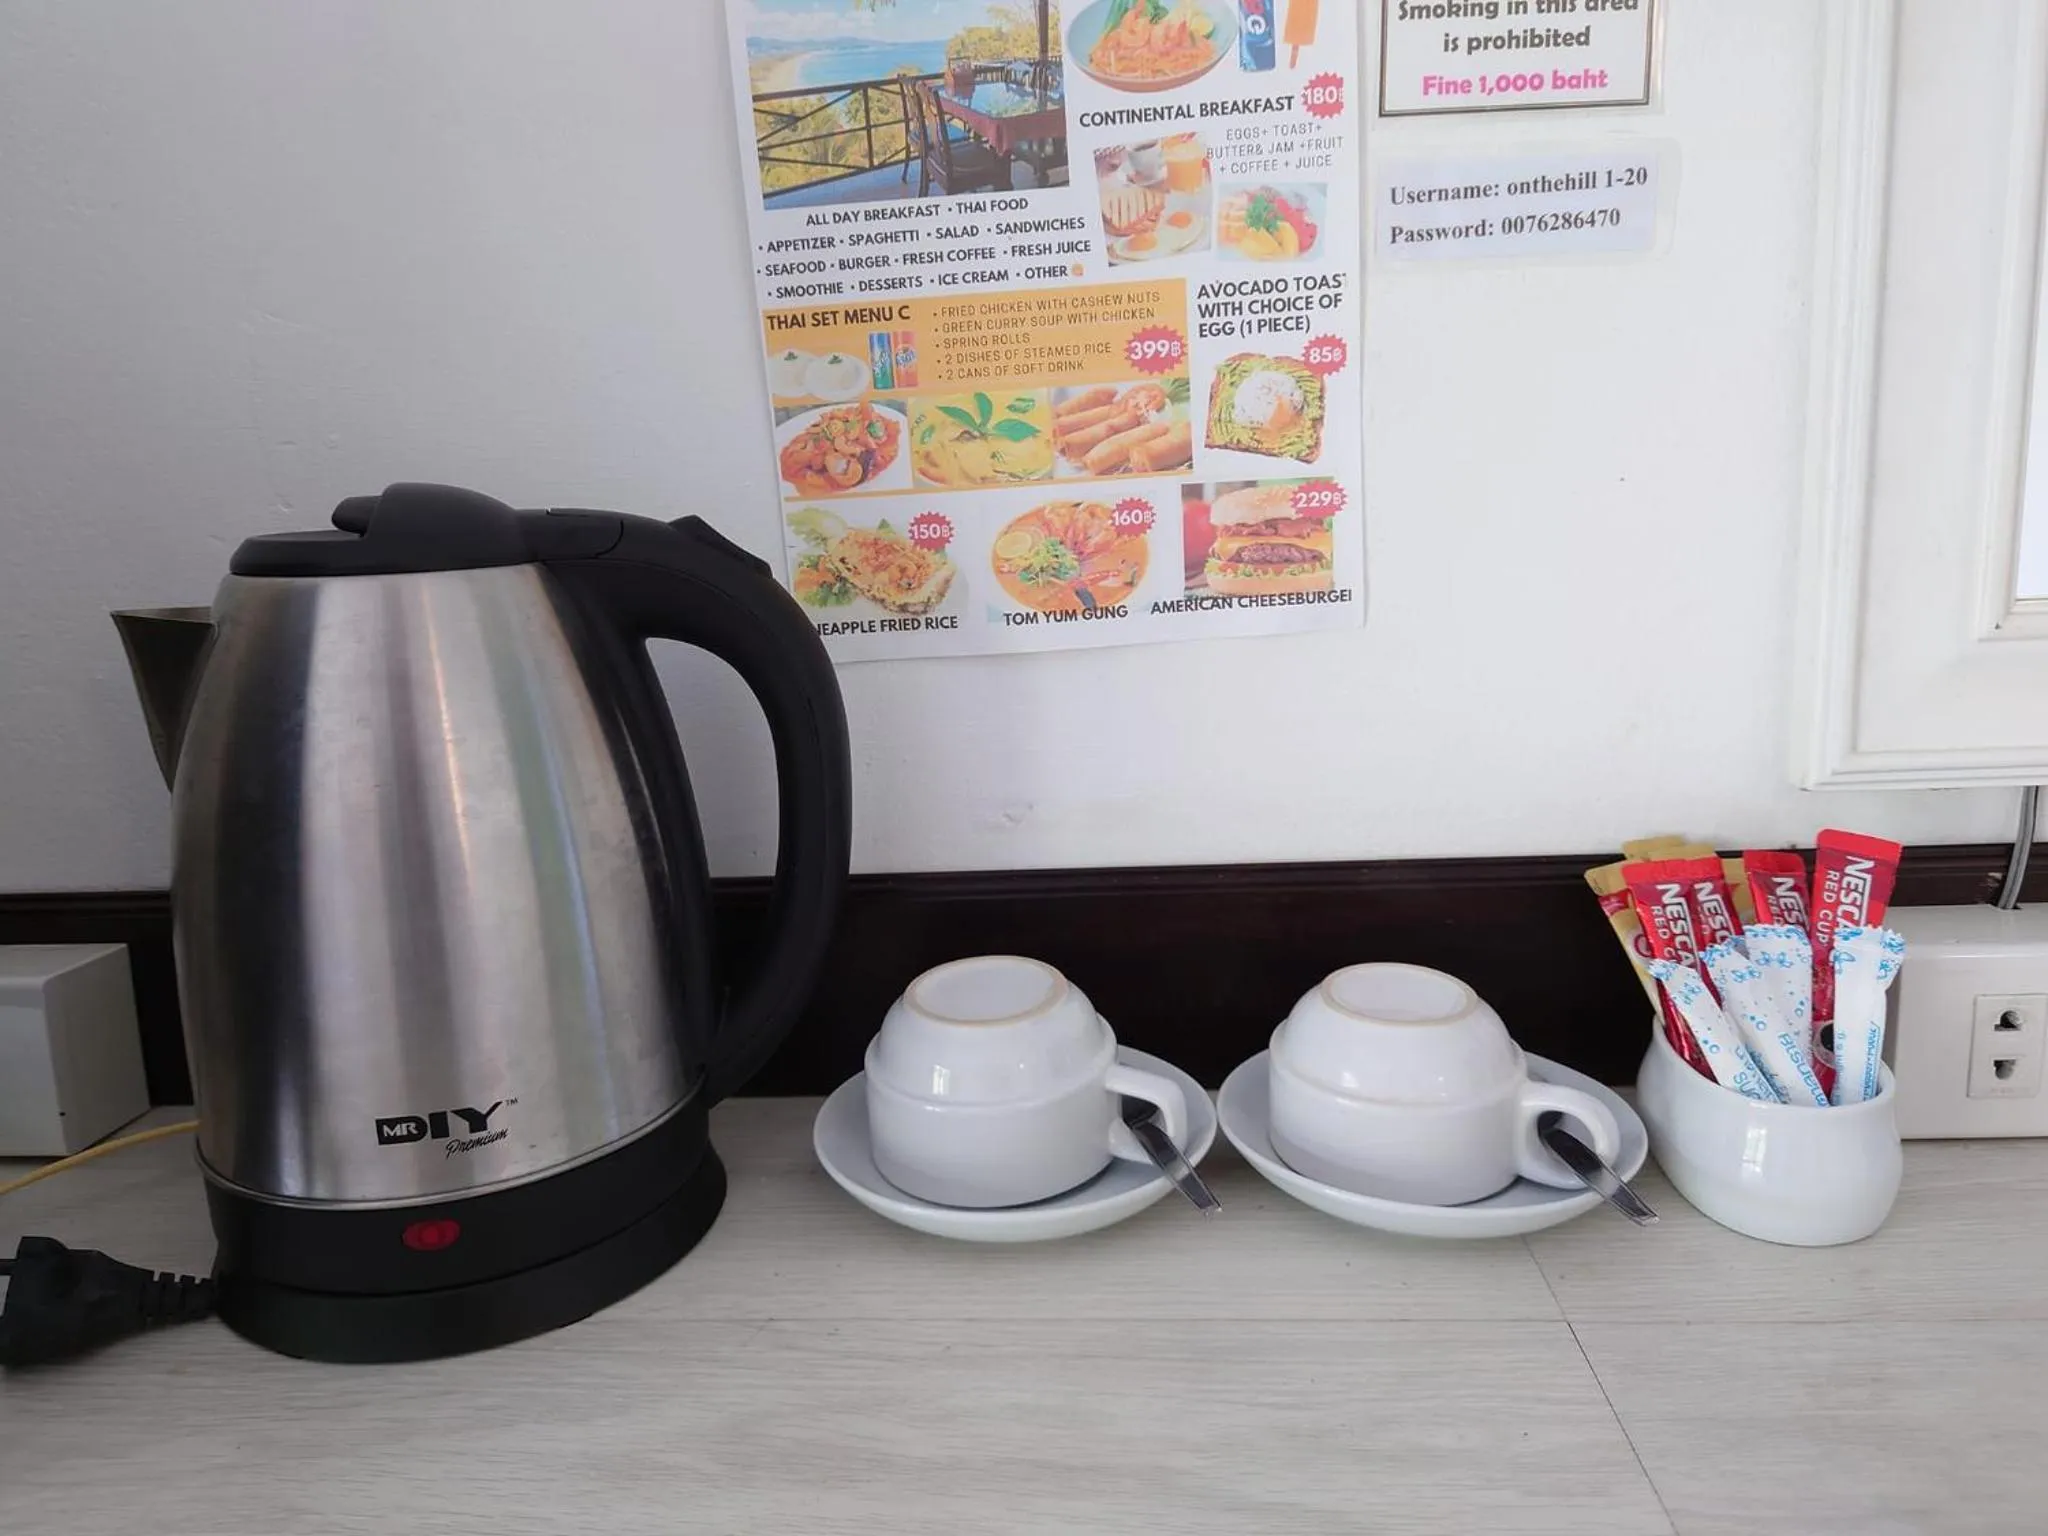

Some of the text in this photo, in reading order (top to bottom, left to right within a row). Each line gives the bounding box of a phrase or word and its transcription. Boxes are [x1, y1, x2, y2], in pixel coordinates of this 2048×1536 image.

[1398, 0, 1639, 20] Smoking in this area
[1443, 25, 1591, 55] is prohibited
[1422, 69, 1609, 96] Fine 1,000 baht
[1079, 96, 1295, 128] CONTINENTAL BREAKFAST
[1268, 141, 1294, 154] JAM
[1230, 158, 1279, 174] COFFEE
[1295, 154, 1333, 169] JUICE
[1390, 166, 1648, 206] Username: onthehill 1-20
[806, 197, 1029, 227] ALL DAY BREAKFAST THAI FOOD
[766, 216, 1086, 253] APPETIZER SPAGHETTI SALAD SANDWICHES
[1390, 208, 1621, 244] Password: 0076286470
[765, 239, 1092, 277] SEAFOOD BURGER FRESH COFFEE FRESH JUICE
[776, 266, 1069, 299] SMOOTHIE DESSERTS ICE CREAM OTHER
[1197, 278, 1289, 300] AVOCADO
[767, 304, 911, 331] THAI SET MENU C
[941, 291, 1161, 318] FRIED CHICKEN WITH CASHEW NUTS
[1197, 292, 1343, 319] WITH CHOICE OF
[942, 307, 1156, 334] GREEN CURRY SOUP WITH CHICKEN
[1199, 314, 1311, 338] EGG (1 PIECE)
[943, 332, 1031, 349] SPRING ROLLS
[944, 341, 1112, 365] 2 DISHES OF STEAMED RICE
[946, 359, 1085, 381] 2 CANS OF SOFT DRINK
[1003, 604, 1129, 626] TOM YUM GUNG
[1150, 598, 1234, 615] AMERICAN
[816, 615, 959, 636] EAPPLE FRIED RICE
[1836, 855, 1876, 930] NESCA
[1815, 869, 1840, 944] RED CUP
[1650, 905, 1671, 940] RED
[1655, 883, 1700, 970] NESCA
[445, 1128, 509, 1160] Premium
